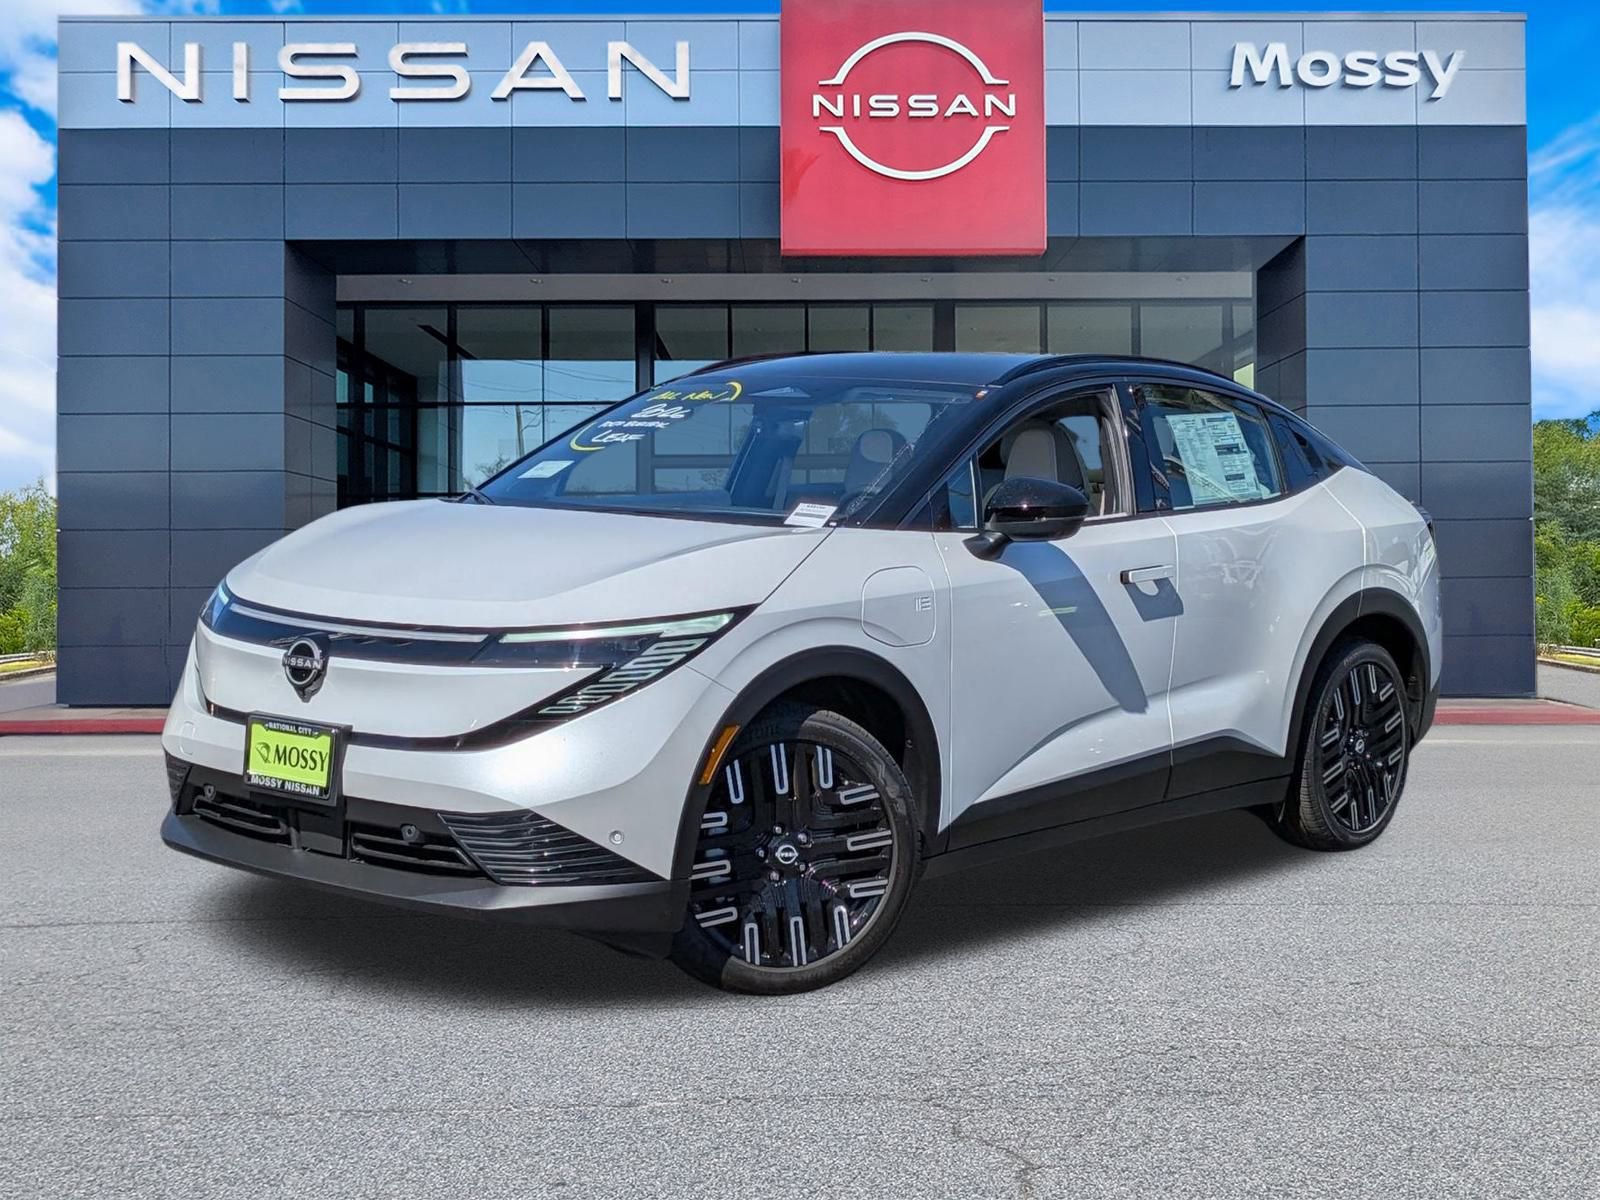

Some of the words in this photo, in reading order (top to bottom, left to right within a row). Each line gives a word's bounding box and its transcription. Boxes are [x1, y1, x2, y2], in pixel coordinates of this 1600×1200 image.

[117, 41, 690, 102] NISSAN
[1229, 42, 1465, 100] Mossy
[812, 93, 1016, 118] NISSAN
[268, 722, 297, 733] NATIONAL
[298, 727, 312, 735] CITY
[273, 744, 328, 772] MOSSY
[250, 775, 282, 789] MOSSY
[284, 781, 320, 796] NISSAN
